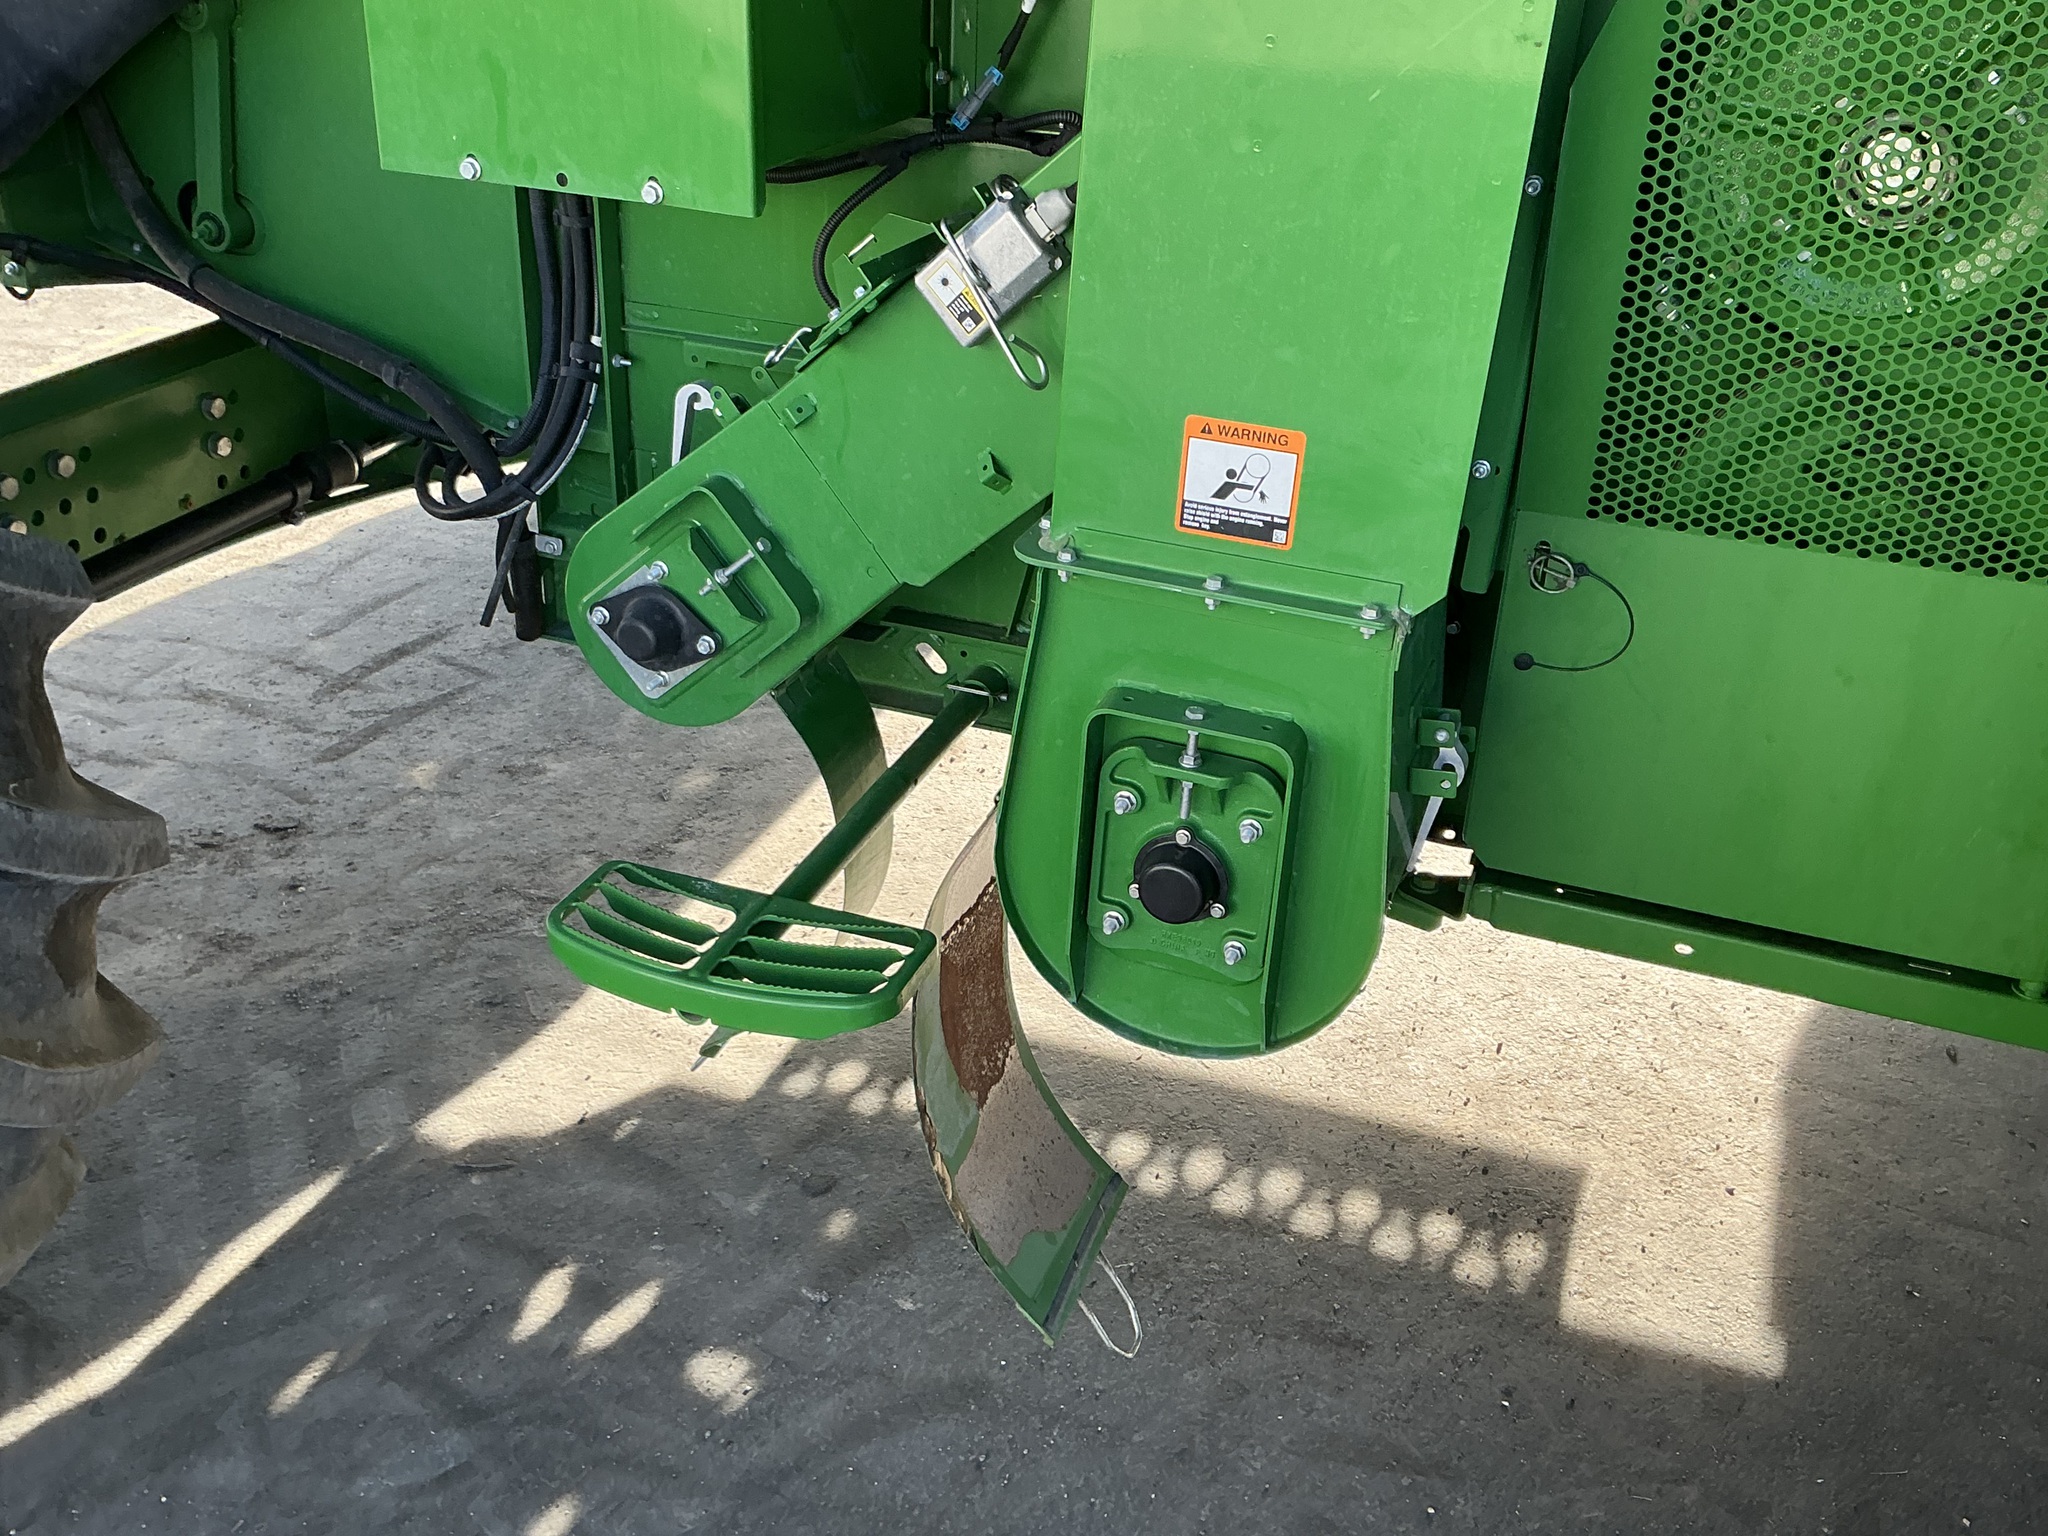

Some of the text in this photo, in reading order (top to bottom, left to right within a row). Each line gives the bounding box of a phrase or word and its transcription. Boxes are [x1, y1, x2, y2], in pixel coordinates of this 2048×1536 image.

[1218, 424, 1288, 446] WARNING
[1194, 515, 1210, 523] engine
[1196, 509, 1210, 517] shield
[1229, 516, 1244, 524] engine
[1198, 503, 1214, 512] serious
[1215, 505, 1228, 515] injury
[1273, 516, 1287, 524] Never
